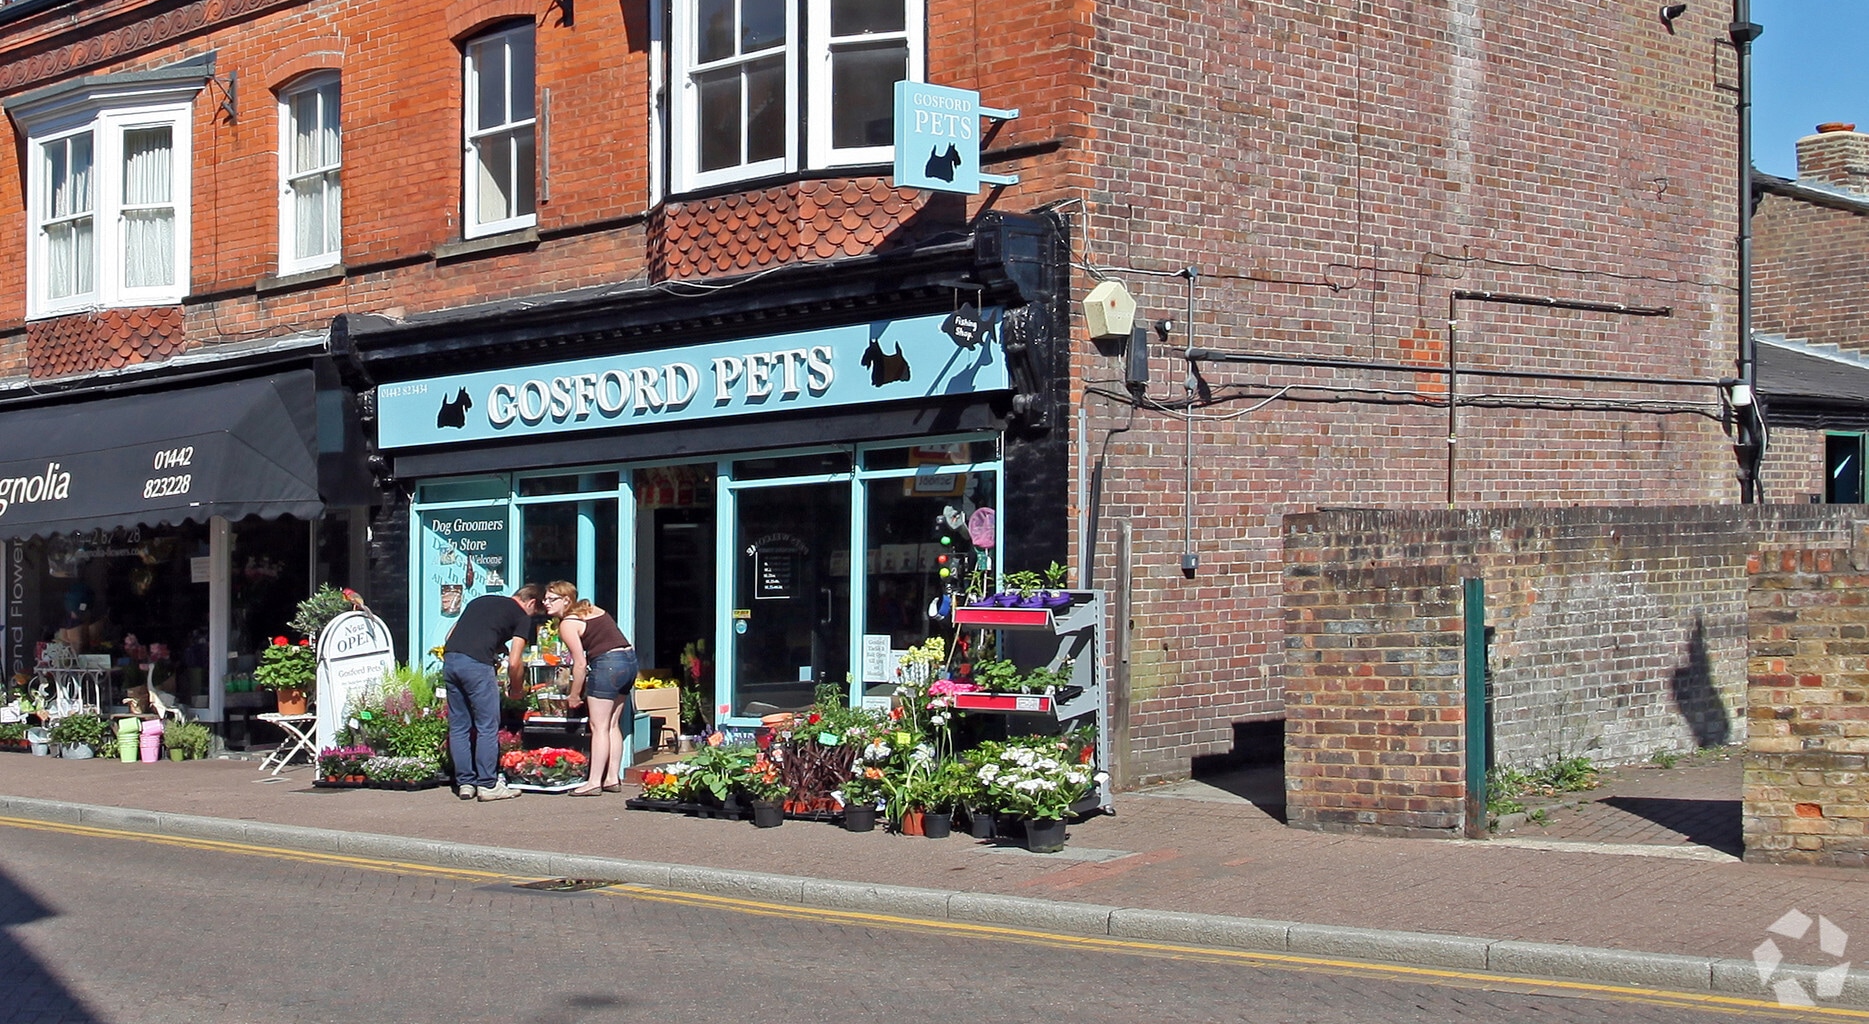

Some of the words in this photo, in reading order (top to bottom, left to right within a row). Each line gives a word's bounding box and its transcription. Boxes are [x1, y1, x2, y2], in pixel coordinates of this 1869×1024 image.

[913, 92, 971, 112] GOSFORD
[914, 109, 972, 140] PETS
[955, 316, 977, 332] Fishing
[486, 362, 700, 429] GOSFORD
[711, 345, 835, 408] PETS
[153, 446, 194, 470] 01442
[143, 474, 192, 499] 823228
[432, 519, 452, 535] Dog
[453, 518, 504, 532] Groomers
[447, 538, 458, 550] In
[460, 537, 487, 551] Store
[11, 536, 24, 617] Flower
[337, 629, 377, 653] OPEN
